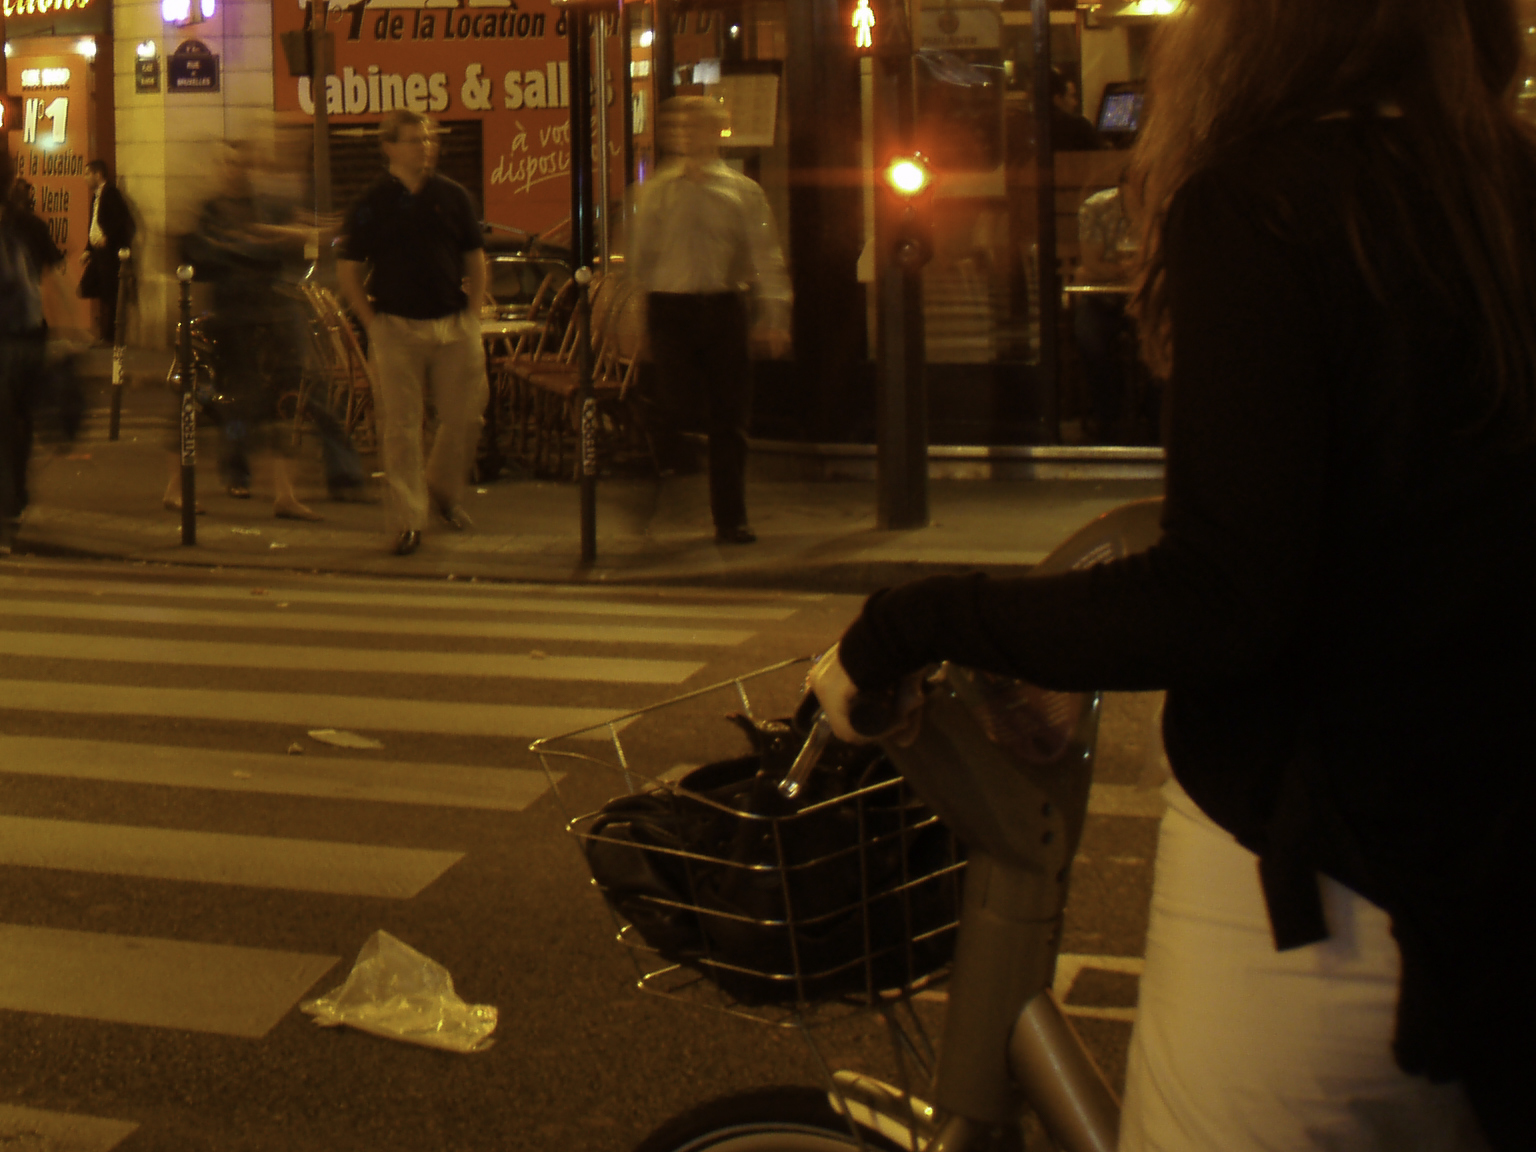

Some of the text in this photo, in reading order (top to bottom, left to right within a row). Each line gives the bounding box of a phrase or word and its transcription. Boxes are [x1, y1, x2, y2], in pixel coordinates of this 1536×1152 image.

[374, 10, 404, 40] de
[412, 7, 434, 41] la
[444, 5, 545, 40] Location
[461, 63, 493, 111] &
[24, 97, 69, 144] N°1
[510, 120, 528, 153] à
[29, 150, 38, 176] la
[42, 148, 84, 177] Location
[42, 186, 70, 213] Vente
